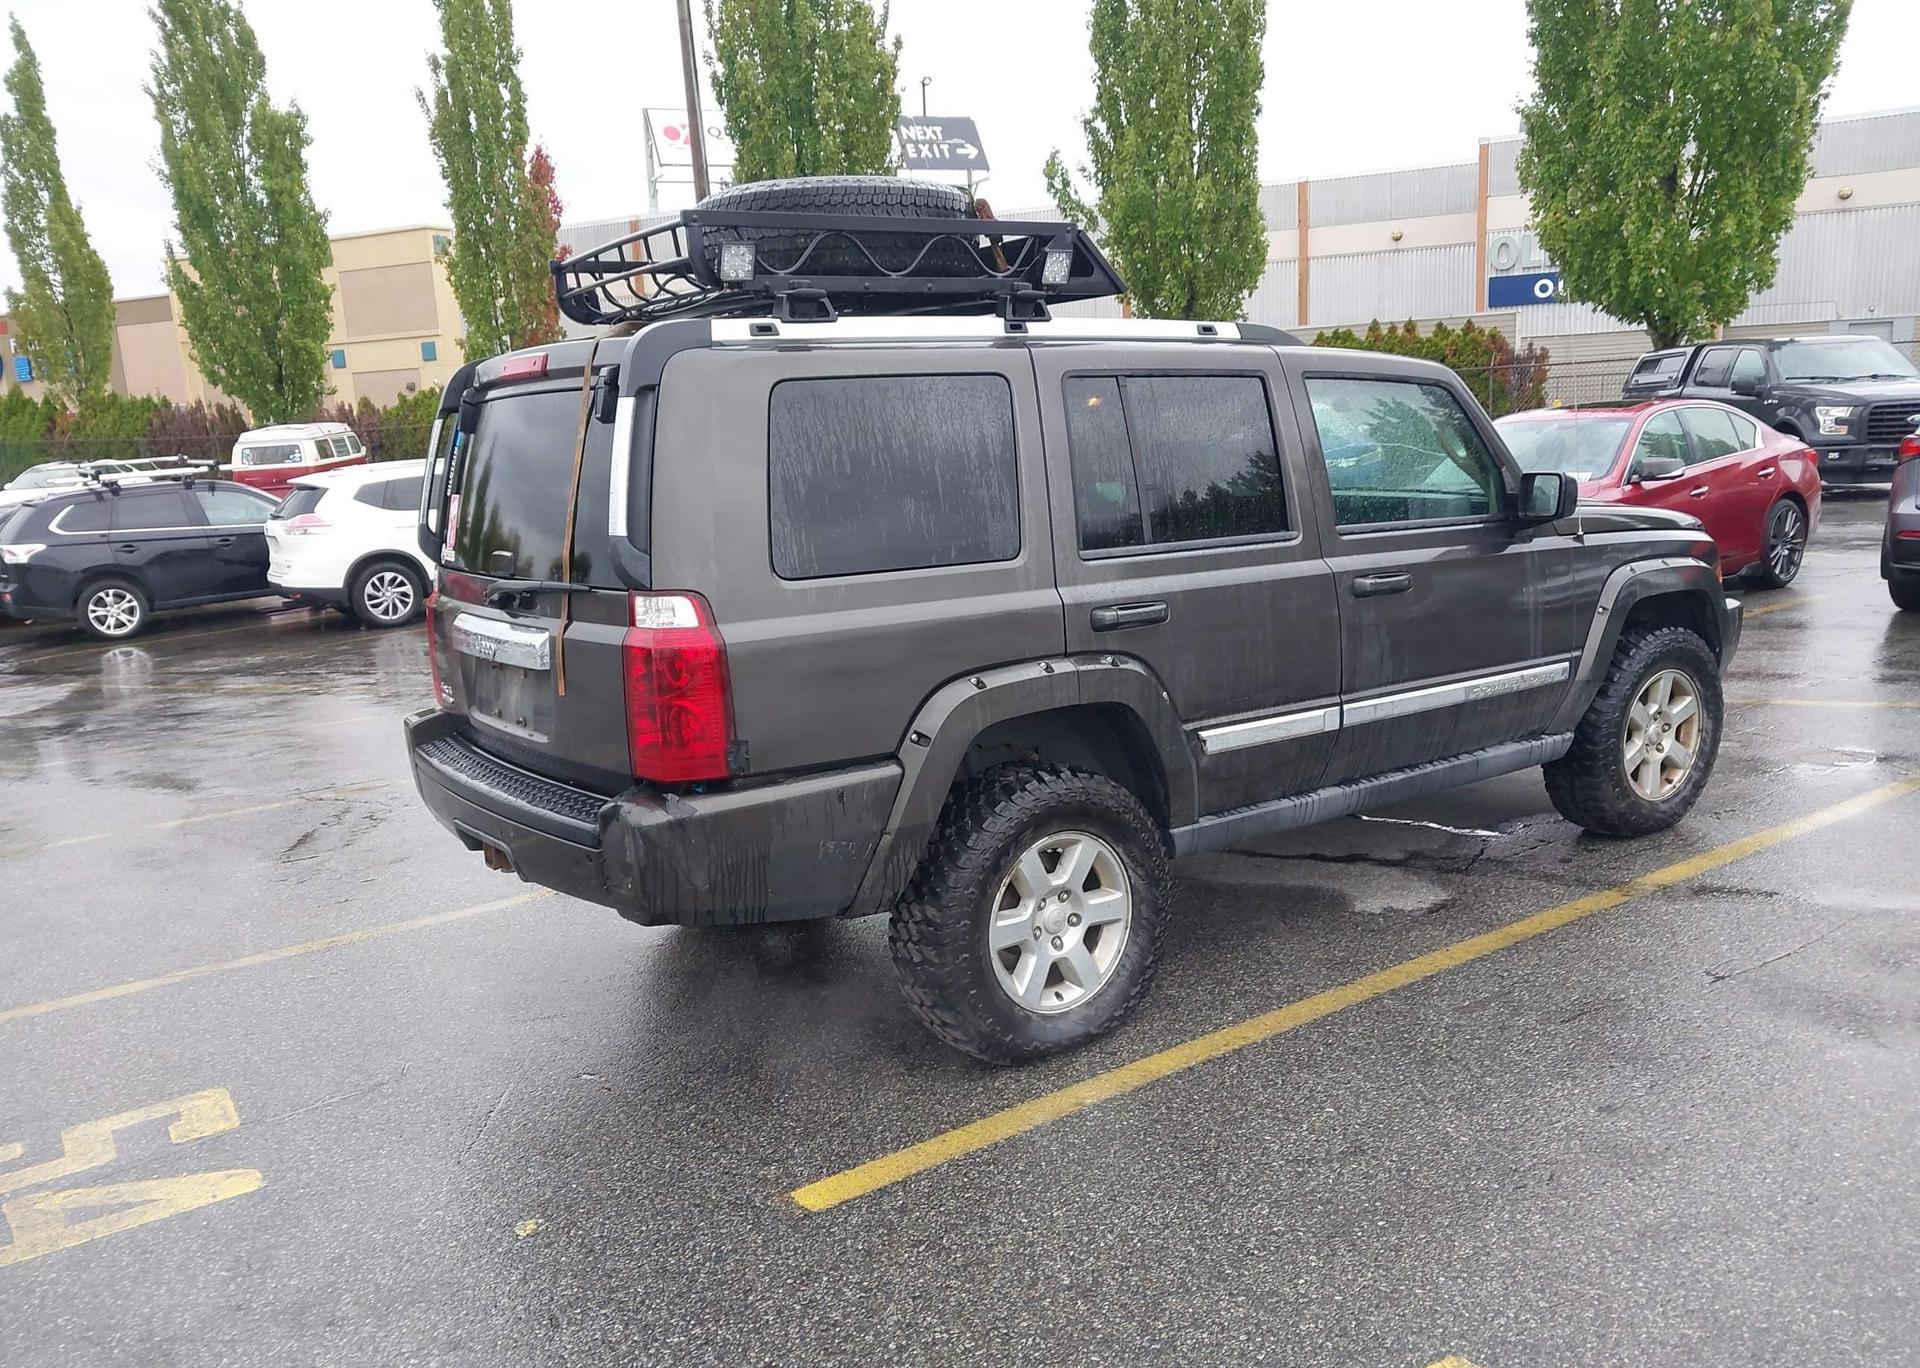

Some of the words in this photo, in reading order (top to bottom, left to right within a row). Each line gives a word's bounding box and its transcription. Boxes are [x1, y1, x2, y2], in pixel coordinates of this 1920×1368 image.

[900, 125, 943, 140] NEXT
[906, 143, 950, 159] EXIT
[1490, 234, 1552, 271] OL
